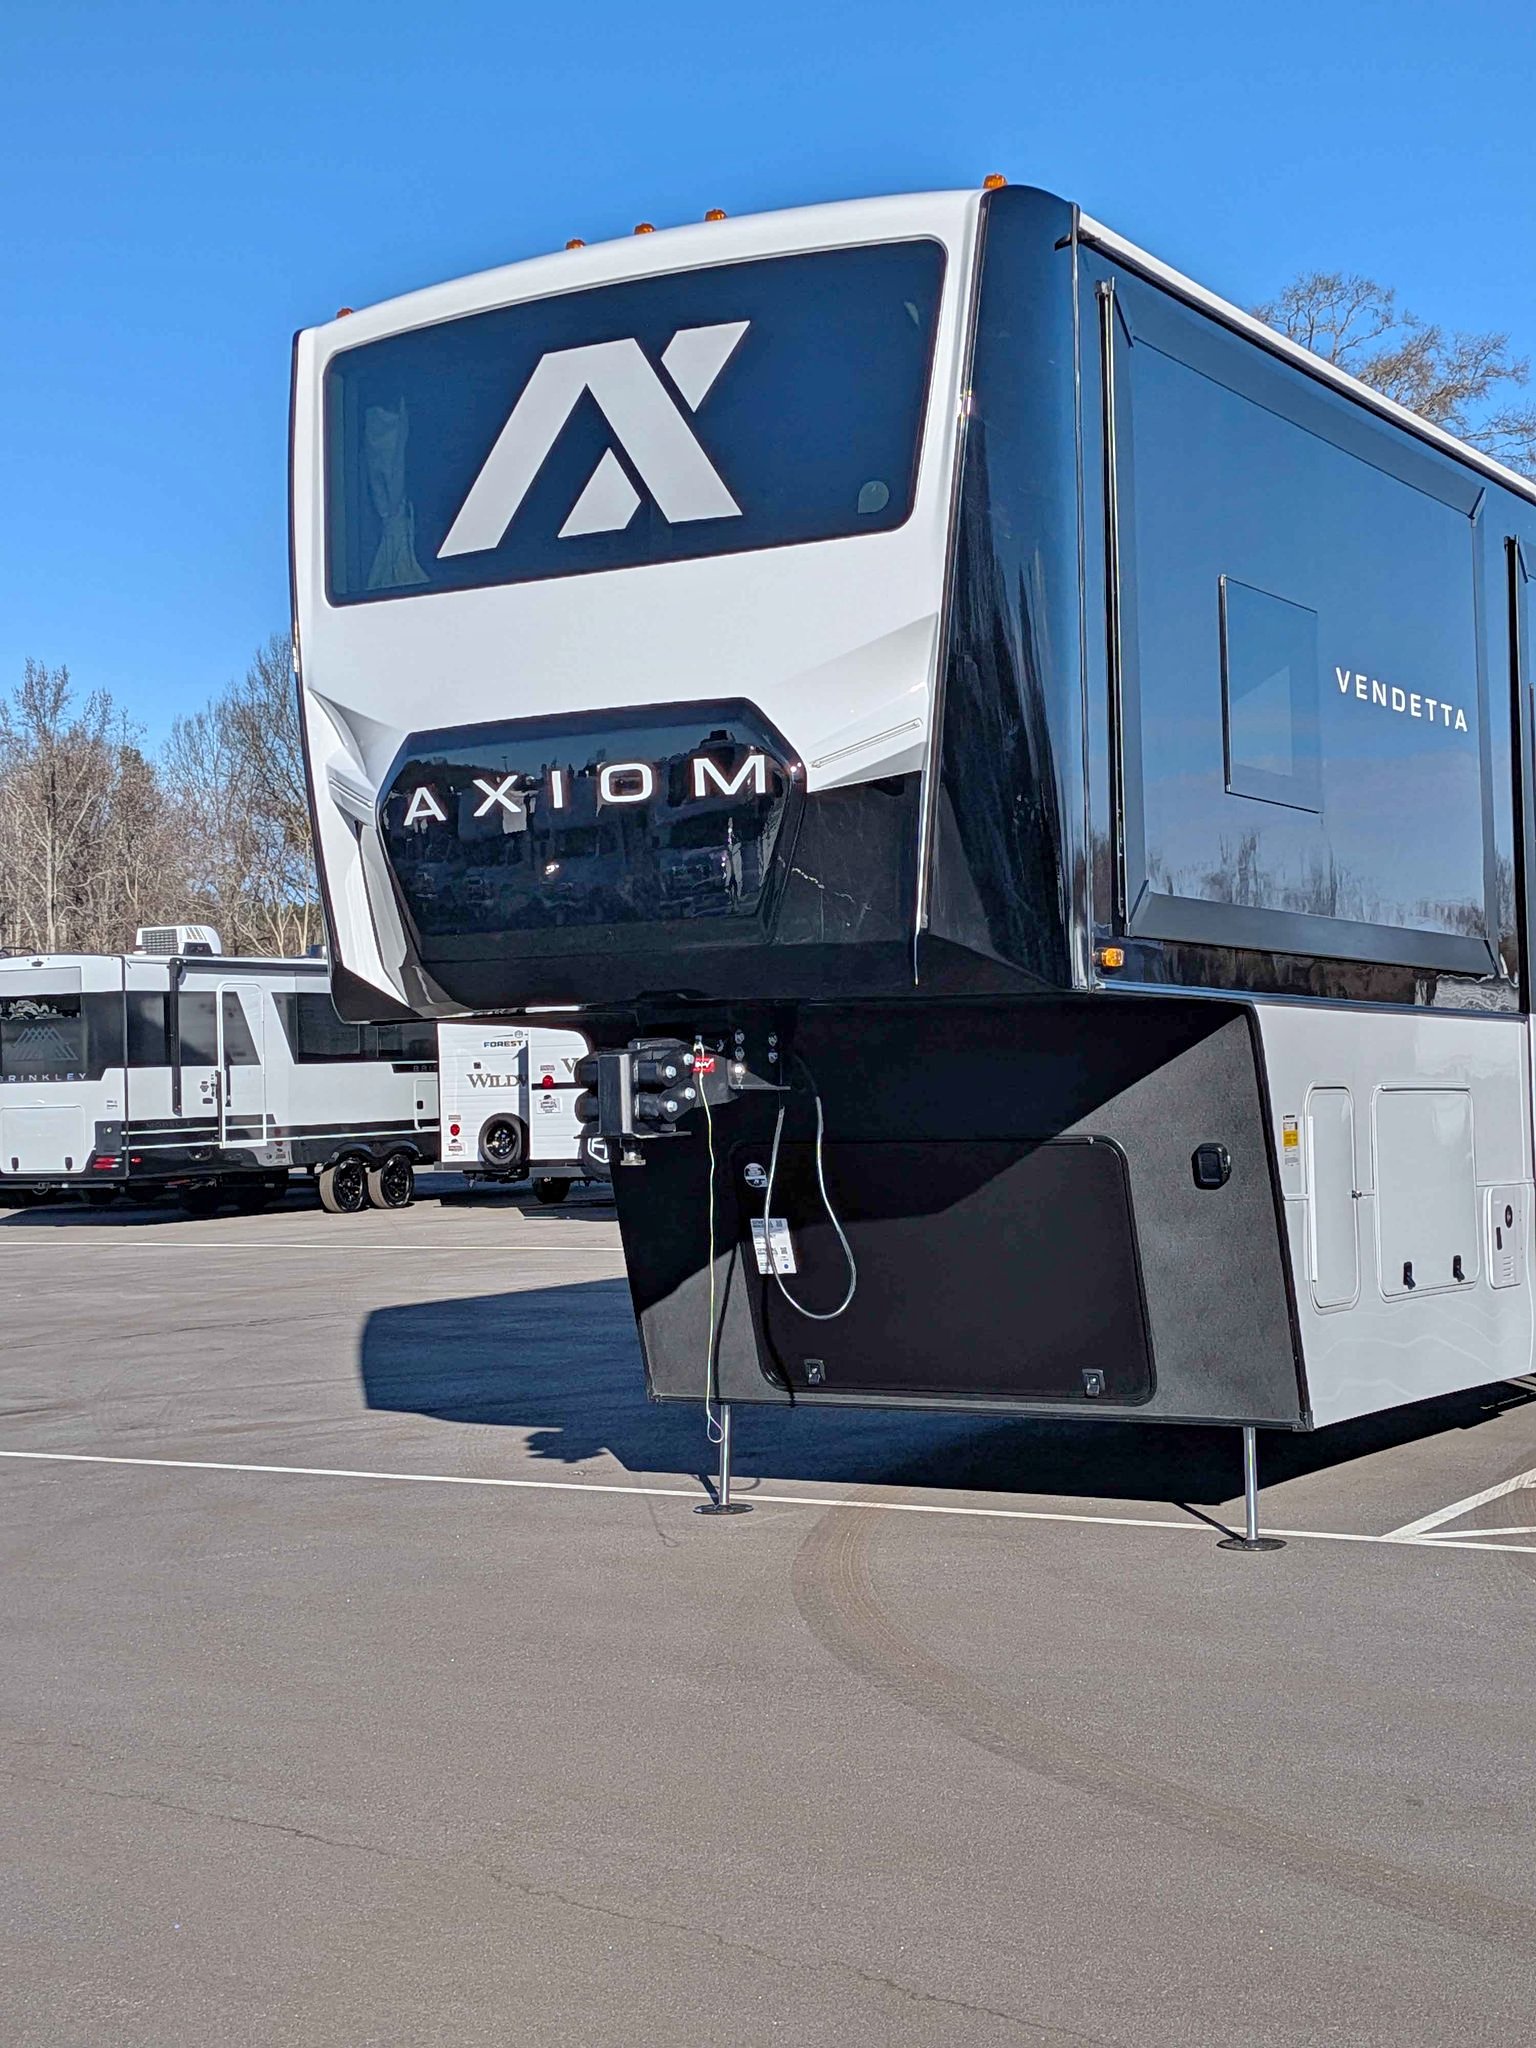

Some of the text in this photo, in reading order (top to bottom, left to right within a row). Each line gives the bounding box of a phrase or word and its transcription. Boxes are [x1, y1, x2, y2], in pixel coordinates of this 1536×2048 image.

[1335, 666, 1468, 732] VENDETTA
[403, 754, 766, 826] AXIOM
[483, 1040, 523, 1048] FOREST
